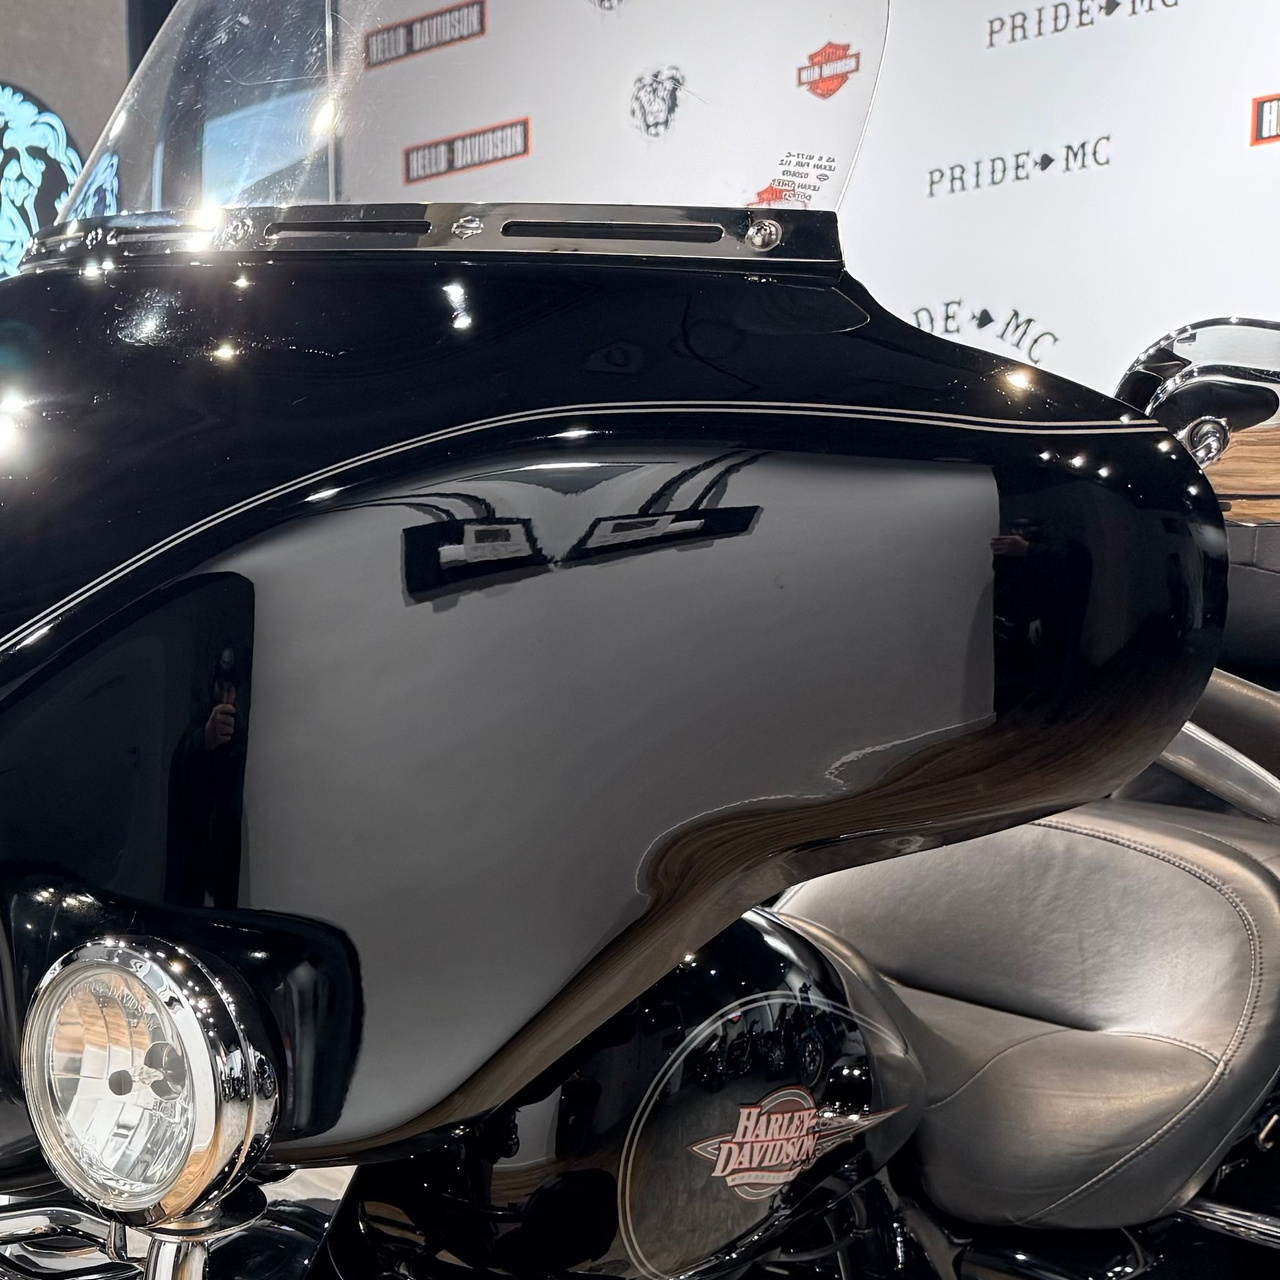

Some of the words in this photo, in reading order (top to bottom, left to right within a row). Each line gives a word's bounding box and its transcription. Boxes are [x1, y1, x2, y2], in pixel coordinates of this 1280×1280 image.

[369, 25, 408, 66] HELLO
[412, 3, 482, 51] DAVIDSON
[987, 0, 1095, 49] PRIDE
[409, 143, 449, 181] HELLO
[454, 121, 526, 169] DAVIDSON
[927, 149, 1031, 198] PRIDE
[1063, 134, 1111, 173] MC
[996, 308, 1061, 365] MC
[711, 1133, 820, 1177] DAVIDSON
